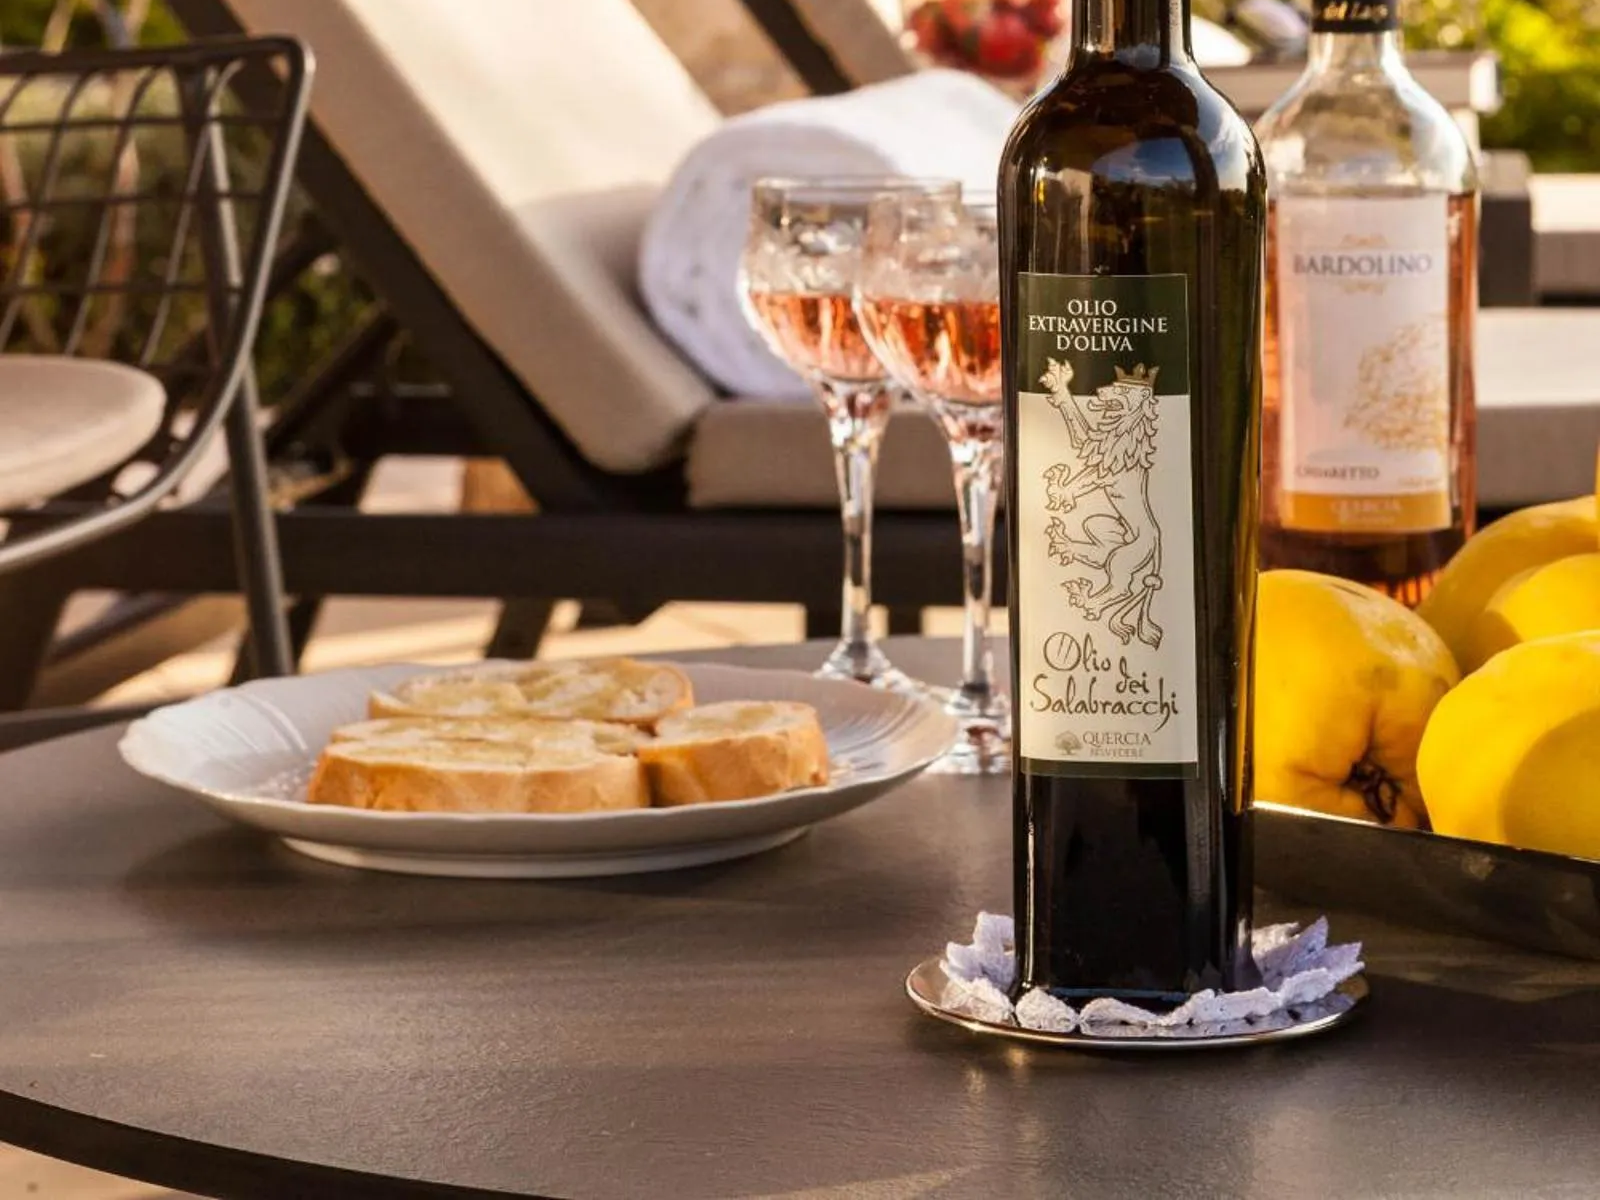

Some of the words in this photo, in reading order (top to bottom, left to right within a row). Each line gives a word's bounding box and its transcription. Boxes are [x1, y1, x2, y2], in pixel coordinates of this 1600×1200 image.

[1293, 254, 1432, 275] BARDOLINO
[1067, 300, 1117, 316] OLIO
[1028, 315, 1168, 333] EXTRAVERGINE
[1056, 335, 1134, 351] D'OLIVA
[1043, 631, 1111, 672] Olio
[1116, 656, 1150, 694] dei
[1030, 673, 1178, 733] Salabracchi
[1082, 731, 1152, 747] QUERCIA
